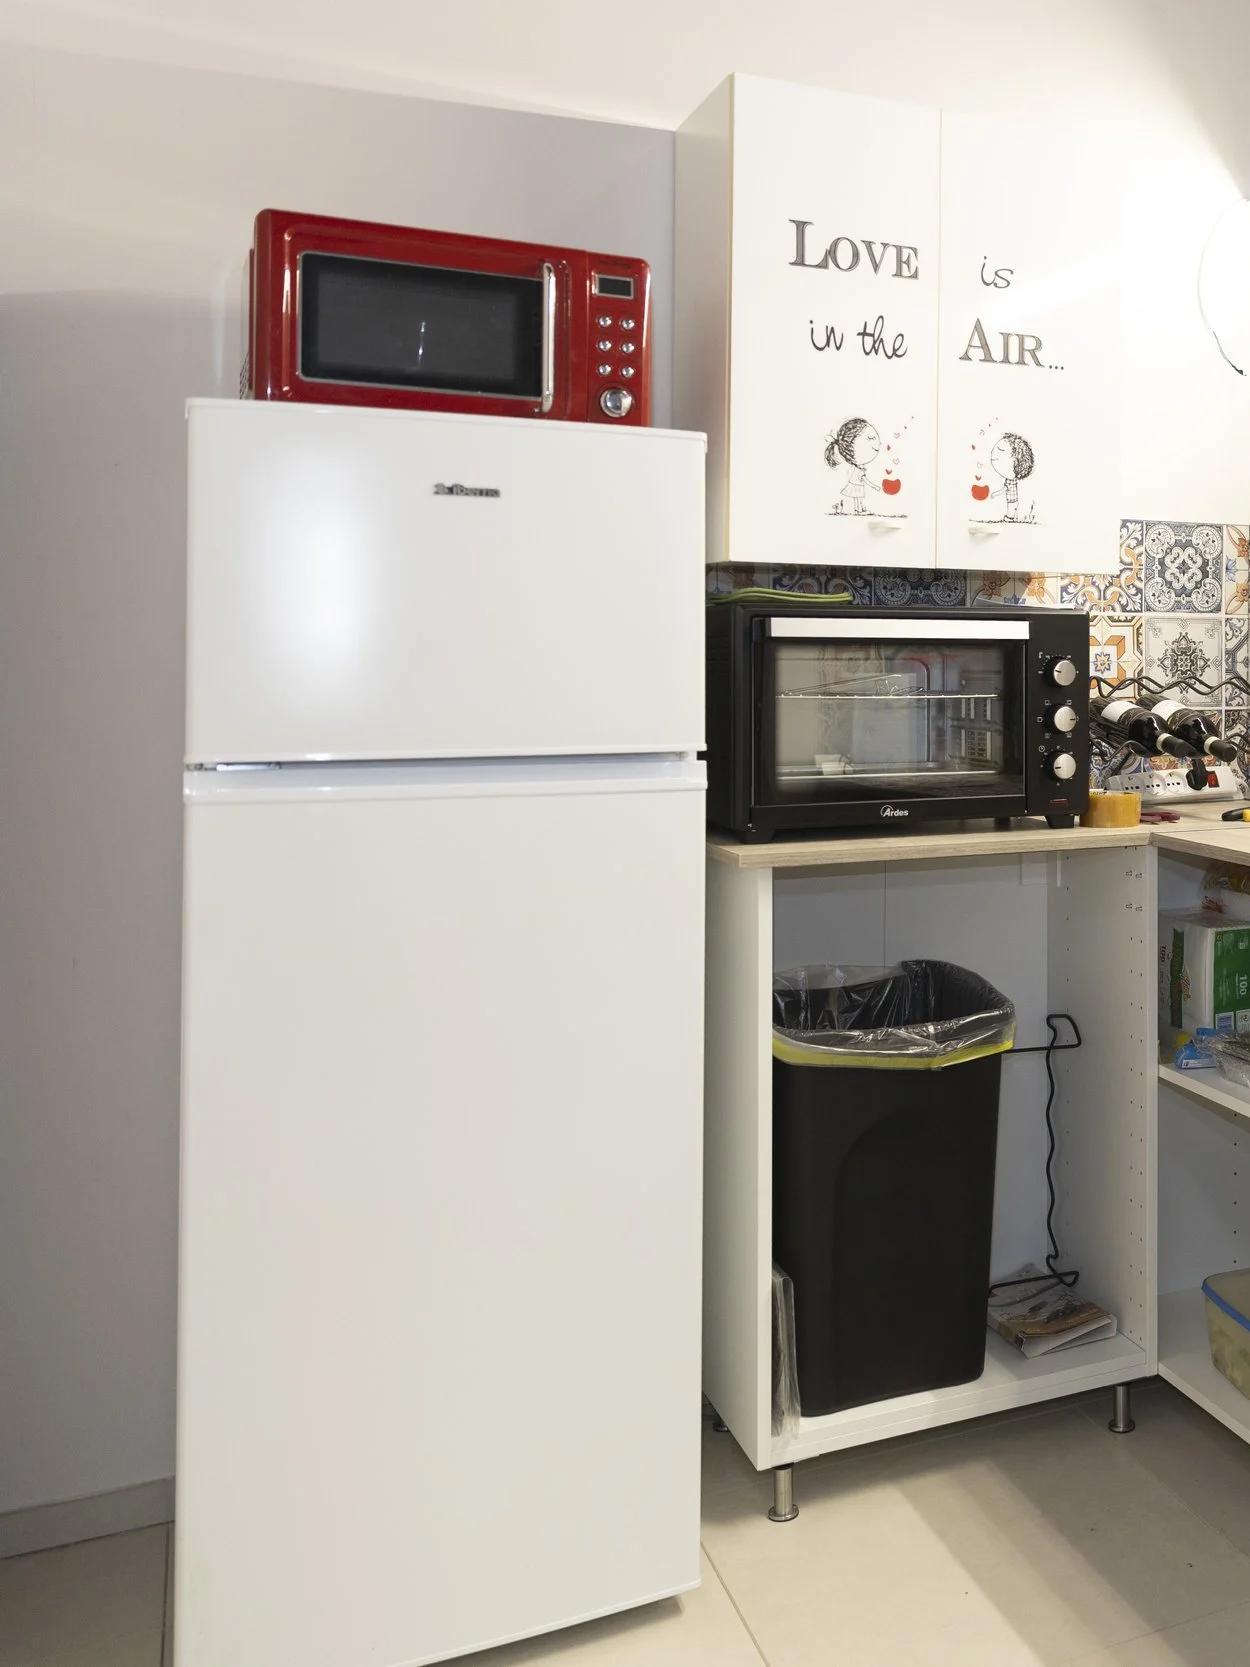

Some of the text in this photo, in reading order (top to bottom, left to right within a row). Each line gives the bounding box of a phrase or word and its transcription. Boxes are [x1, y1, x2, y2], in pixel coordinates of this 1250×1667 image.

[788, 218, 1014, 289] LOVE is
[809, 314, 1065, 371] in the AIR...
[881, 806, 909, 817] Ardes
[1239, 975, 1248, 996] 100
